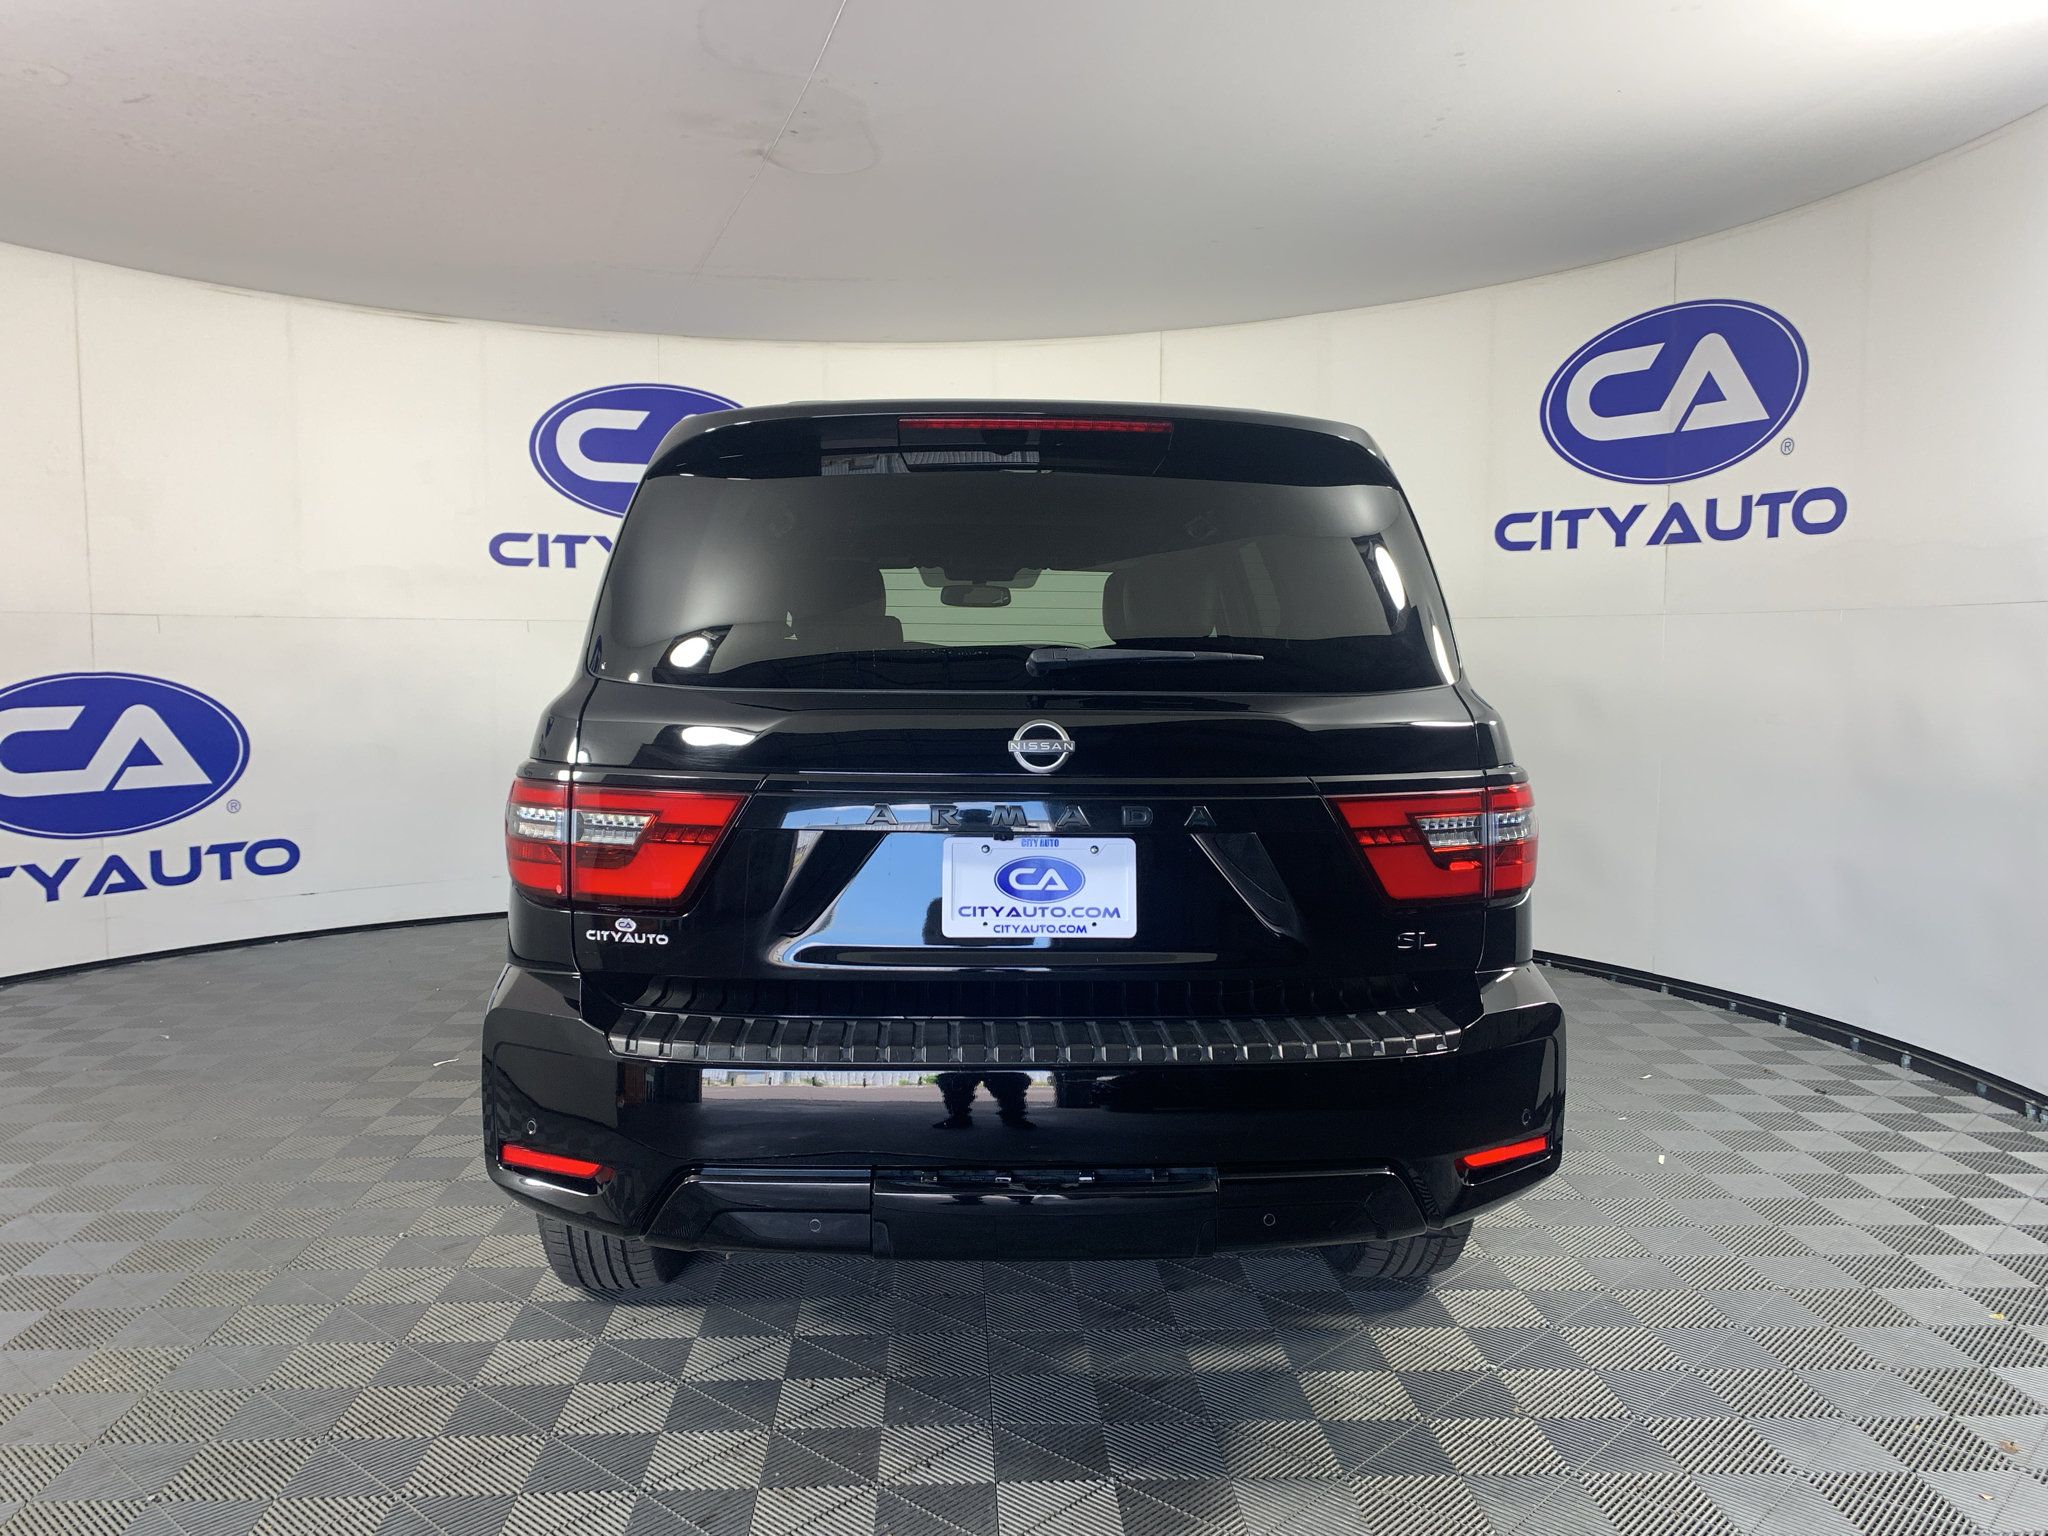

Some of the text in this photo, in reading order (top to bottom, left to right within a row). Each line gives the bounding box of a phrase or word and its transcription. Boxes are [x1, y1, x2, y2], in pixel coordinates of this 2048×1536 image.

[1566, 332, 1770, 441] CA
[0, 703, 213, 798] CA
[1010, 741, 1074, 751] NISSAN
[865, 803, 1217, 828] ARMADA
[1021, 838, 1060, 848] CITY AUTO
[1008, 867, 1070, 891] CA
[958, 906, 1121, 919] CITYAUTO.COM
[585, 929, 669, 945] CITYAUTO
[993, 924, 1087, 934] CITYAUTO.COM
[1397, 931, 1438, 949] SL
